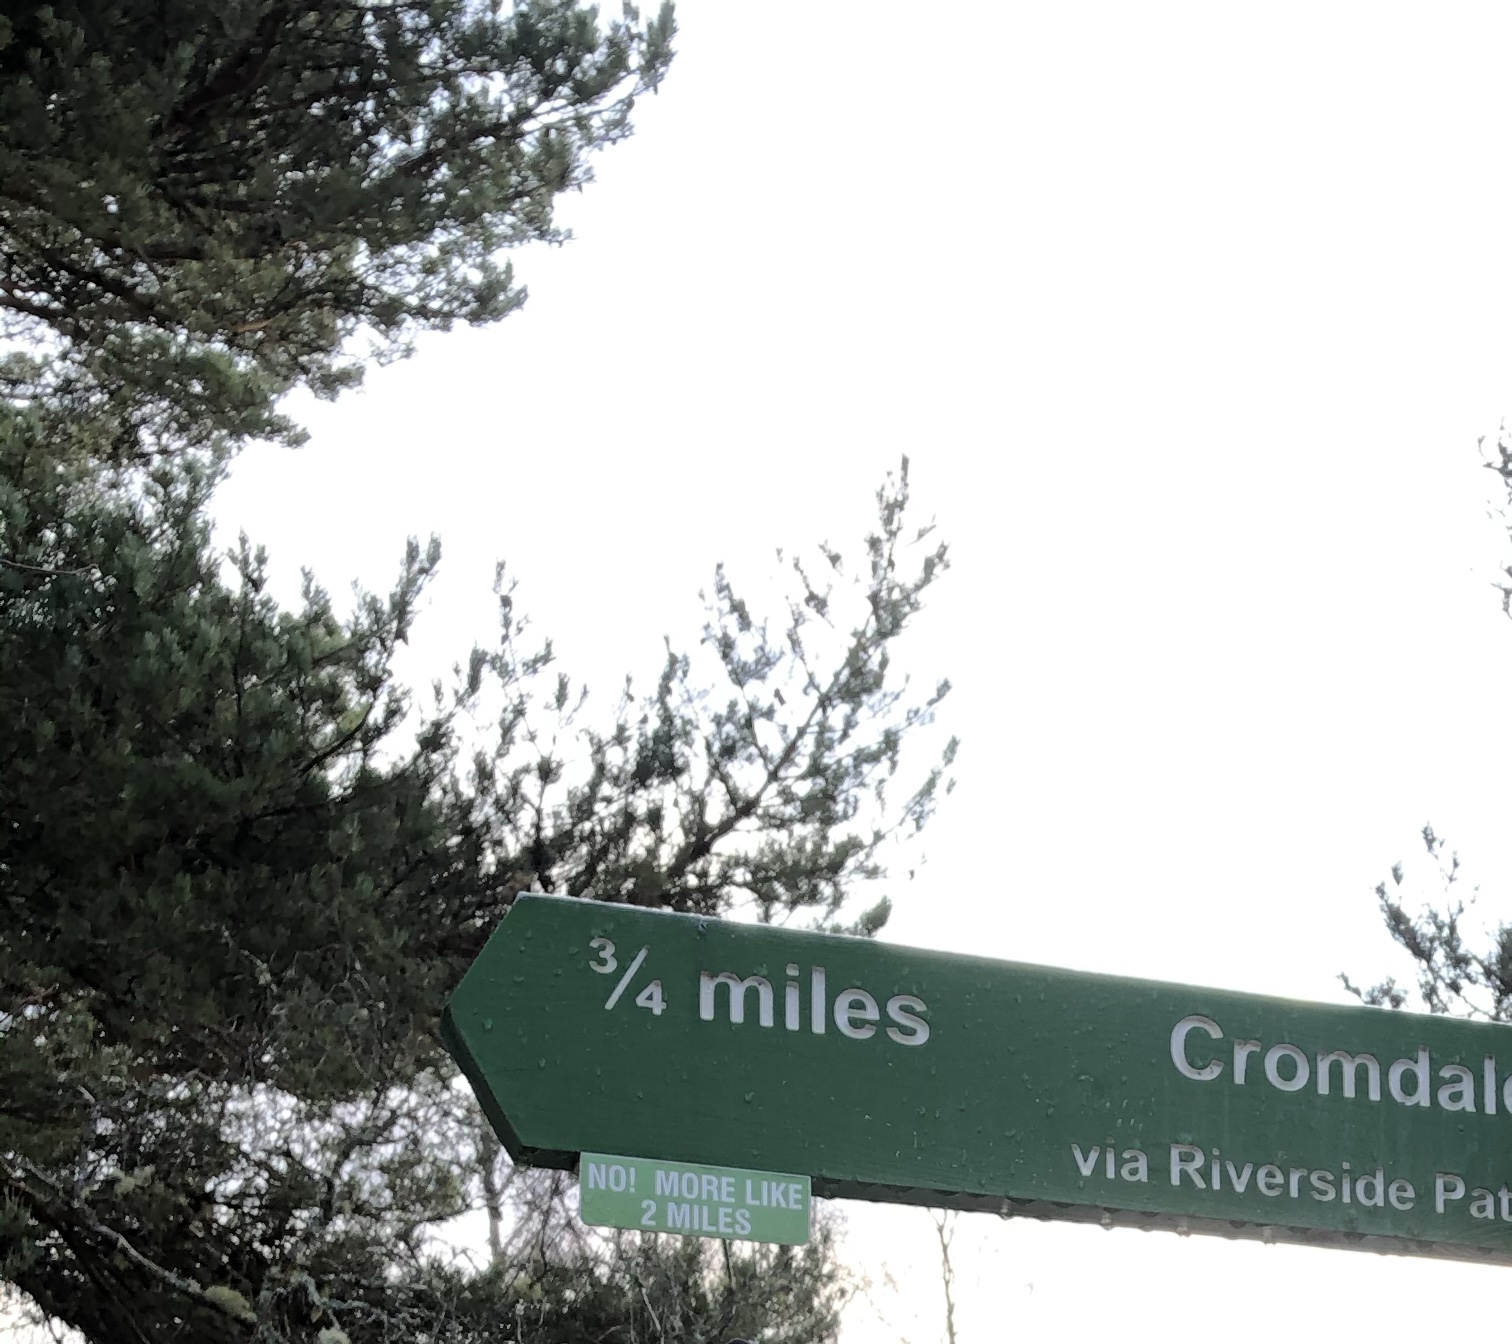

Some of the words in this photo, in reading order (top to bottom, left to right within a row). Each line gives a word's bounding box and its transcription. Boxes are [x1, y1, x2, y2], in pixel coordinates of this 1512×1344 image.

[700, 963, 931, 1047] miles
[588, 1163, 637, 1196] NO!
[656, 1170, 736, 1205] MORE
[745, 1179, 803, 1211] LIKE
[1071, 1137, 1149, 1184] via
[1169, 1143, 1417, 1211] Riverside
[641, 1200, 658, 1227] 2
[667, 1202, 752, 1236] MILES
